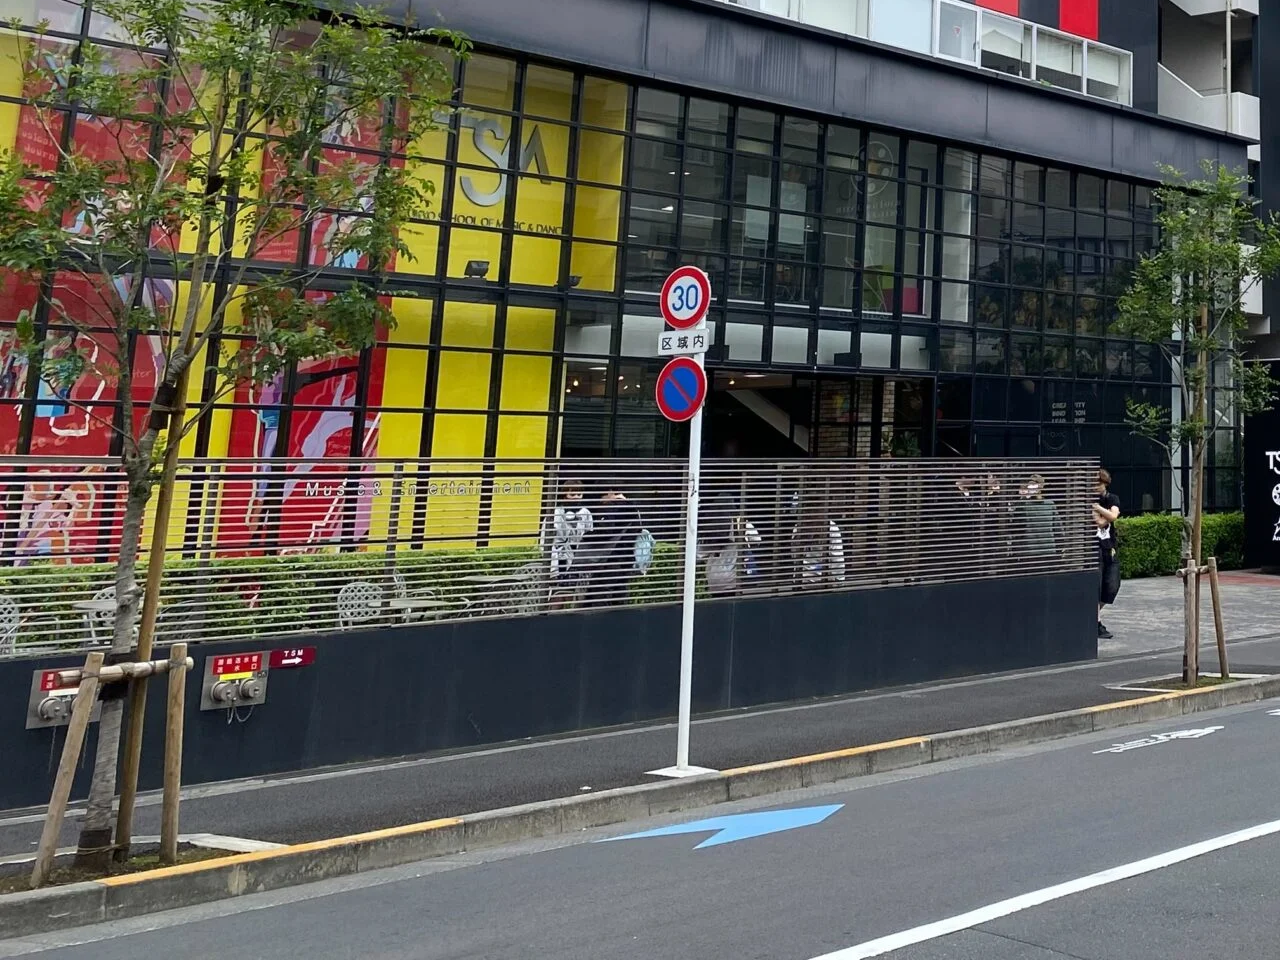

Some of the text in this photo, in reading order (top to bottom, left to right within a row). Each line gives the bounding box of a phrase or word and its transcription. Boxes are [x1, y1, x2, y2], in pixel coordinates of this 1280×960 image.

[672, 284, 698, 311] 30
[662, 335, 704, 350] 区域内
[284, 649, 304, 657] TSM
